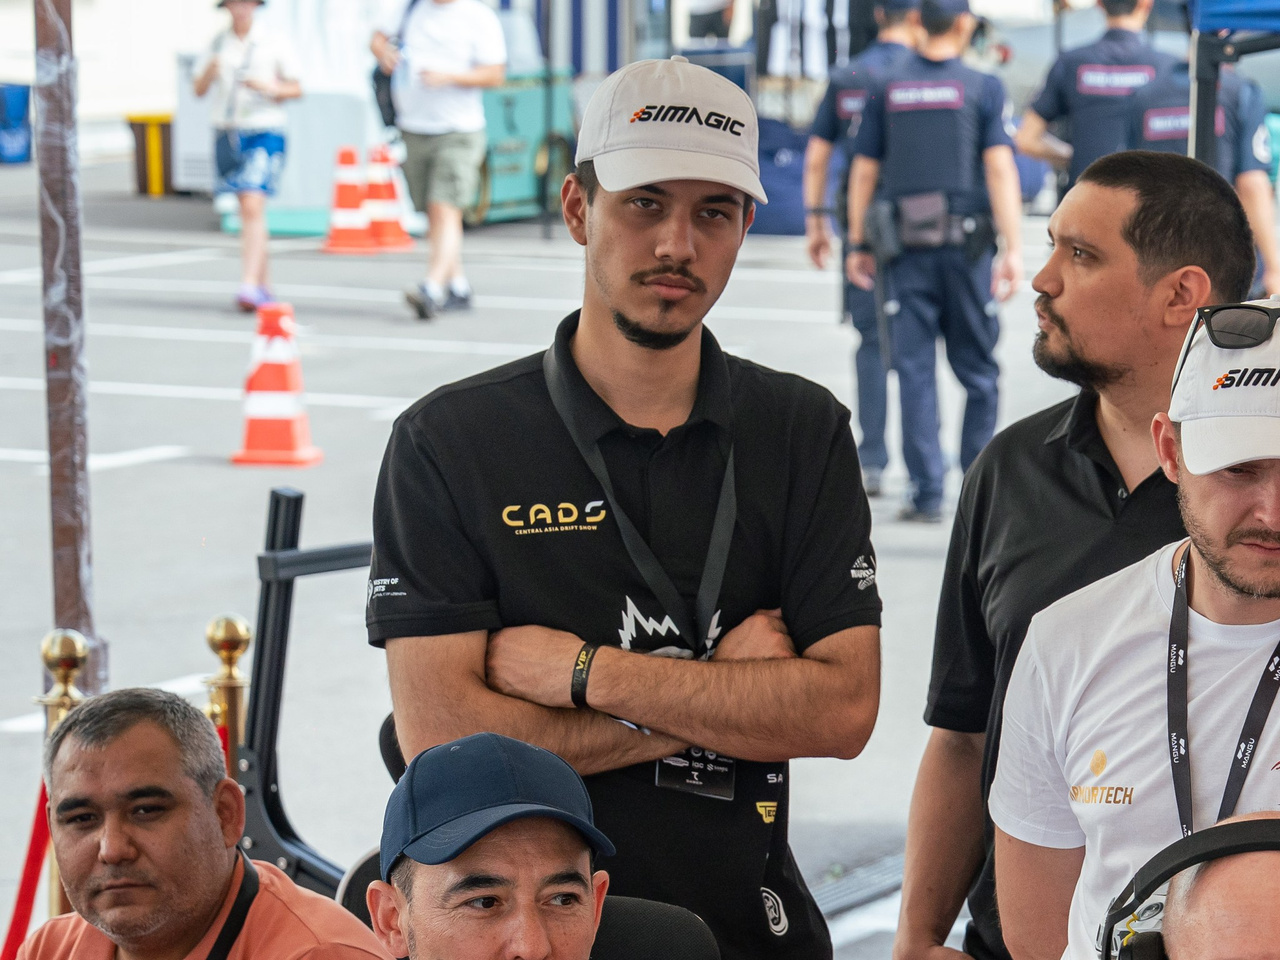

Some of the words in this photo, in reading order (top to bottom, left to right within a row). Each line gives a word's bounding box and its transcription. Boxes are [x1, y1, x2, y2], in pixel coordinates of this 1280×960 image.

[634, 104, 746, 137] SIMAGIC
[502, 500, 606, 527] CADS
[515, 527, 543, 535] CENTRAL
[576, 650, 587, 670] VIP
[1171, 732, 1179, 764] MANGU
[1241, 738, 1255, 769] MANGU
